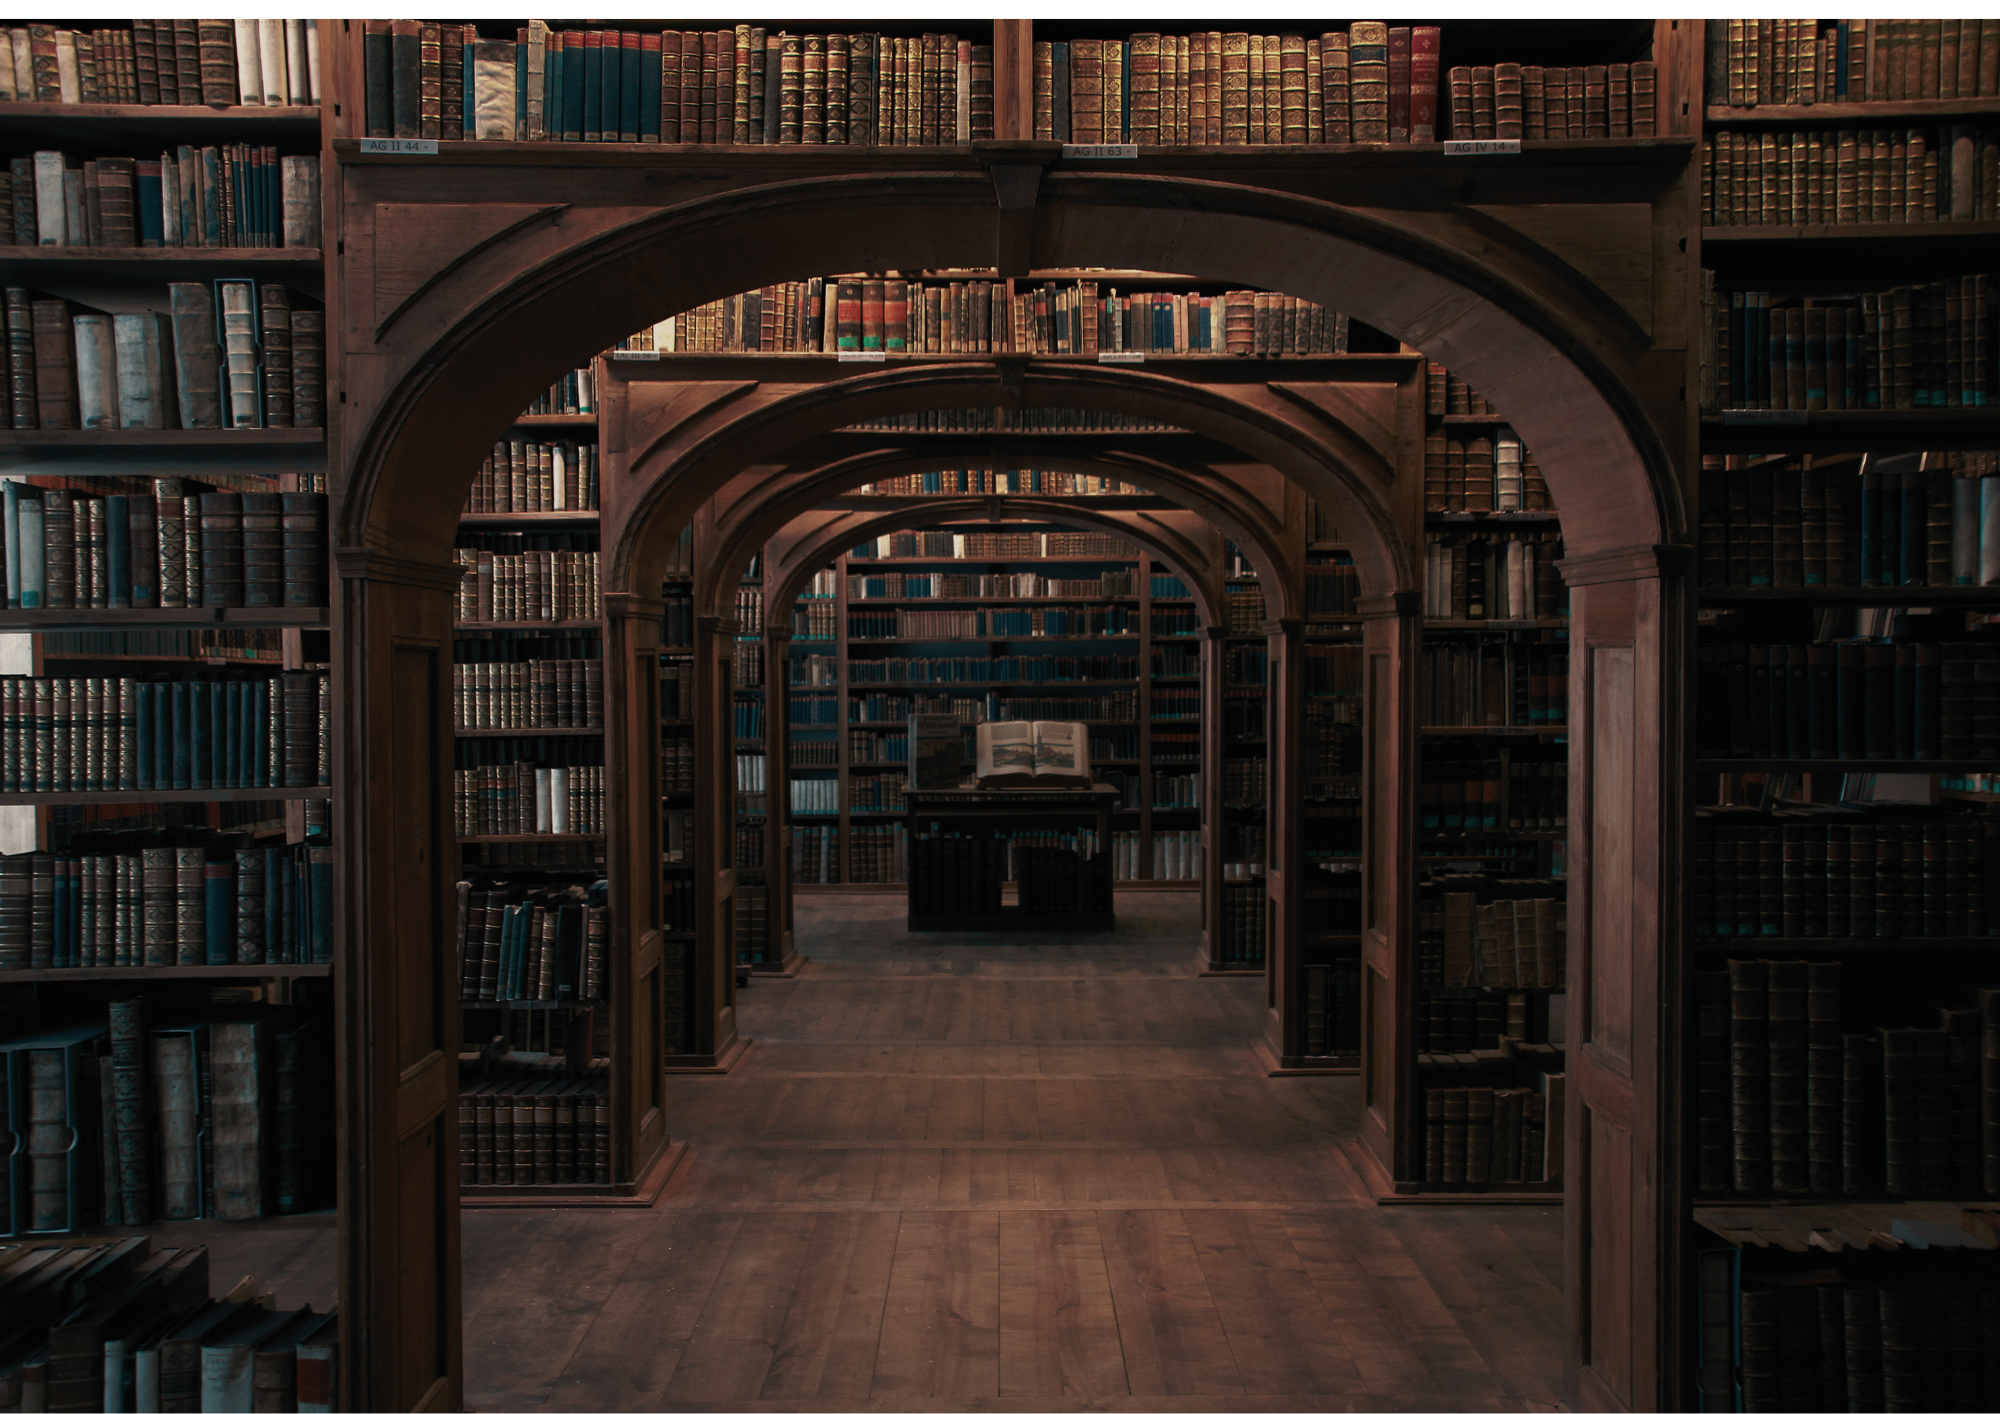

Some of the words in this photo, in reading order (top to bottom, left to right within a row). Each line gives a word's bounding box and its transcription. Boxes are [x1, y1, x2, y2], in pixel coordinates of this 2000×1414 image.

[370, 140, 387, 151] AG
[391, 141, 400, 151] II
[405, 142, 419, 152] 44
[1073, 146, 1090, 156] AG
[1094, 146, 1104, 156] II
[1107, 146, 1122, 156] 63
[1454, 142, 1471, 153] AG
[1475, 142, 1488, 152] IV
[1492, 142, 1506, 152] 14
